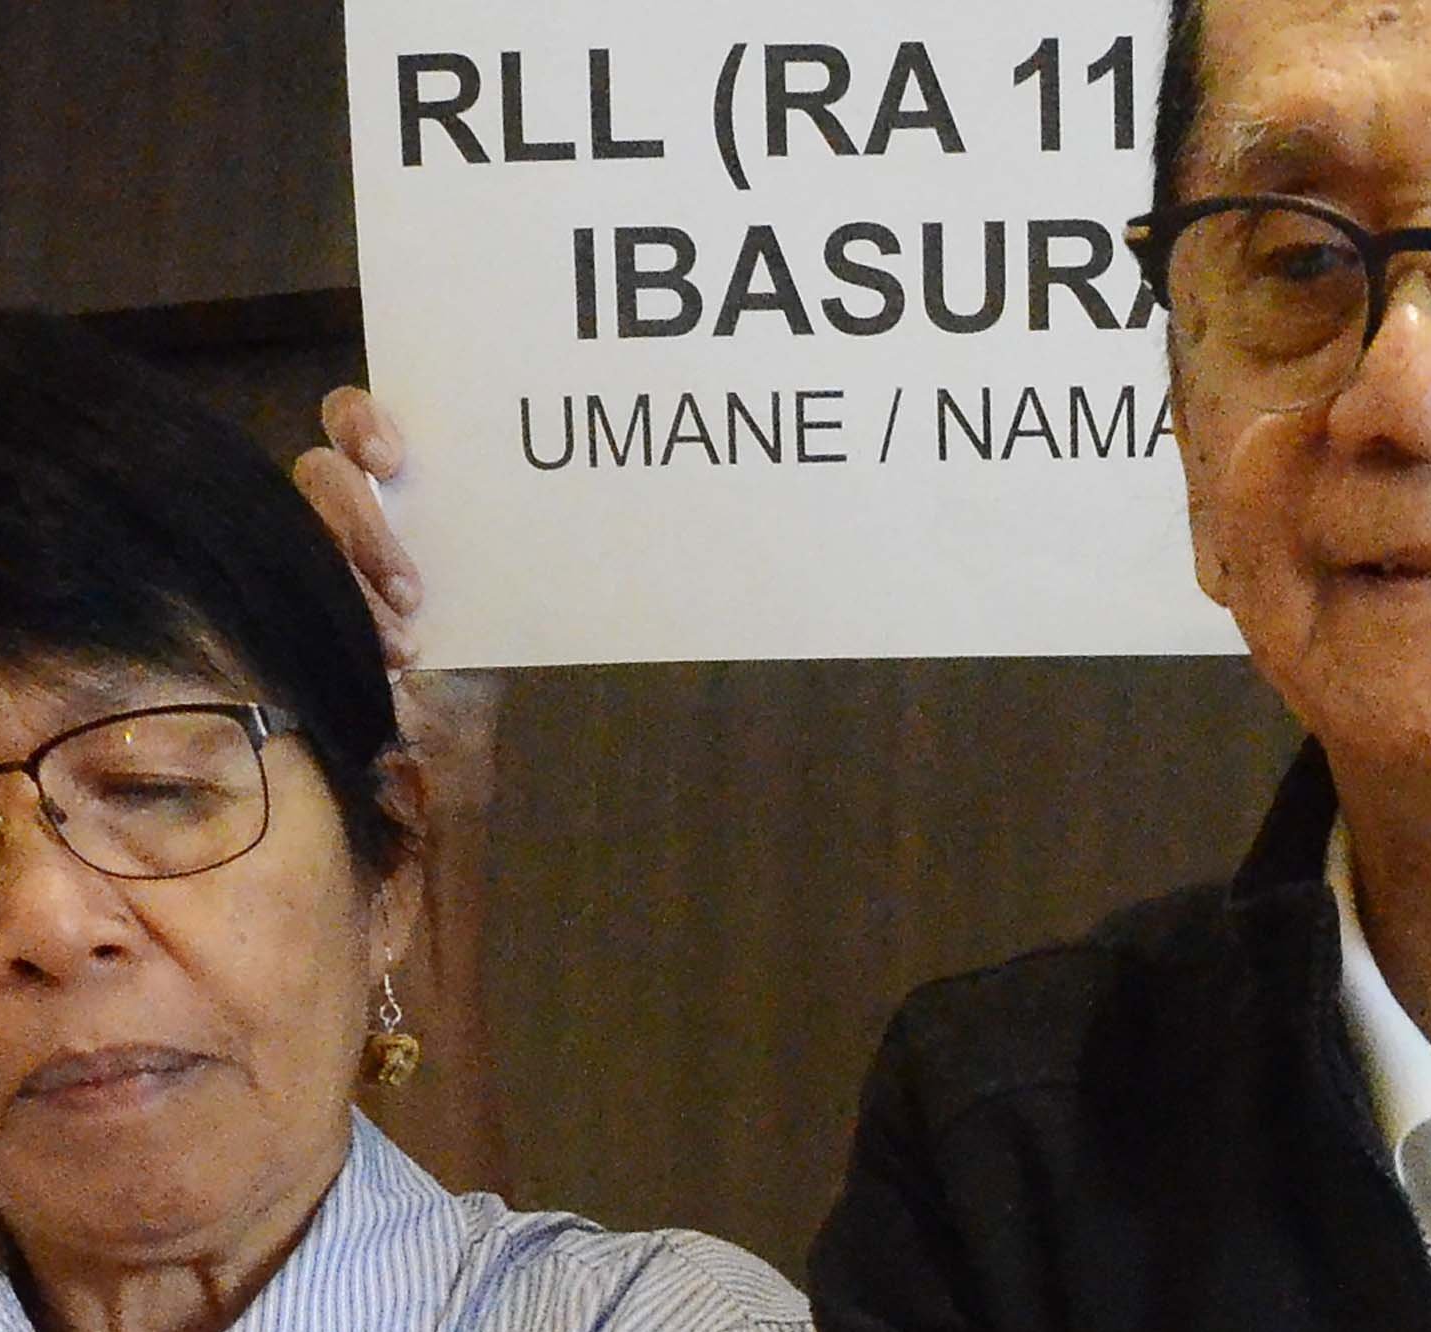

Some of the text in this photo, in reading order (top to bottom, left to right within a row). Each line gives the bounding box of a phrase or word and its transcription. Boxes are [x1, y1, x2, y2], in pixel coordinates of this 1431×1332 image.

[396, 36, 1136, 190] RLL (RA 11
[520, 390, 847, 471] UMANE
[879, 388, 903, 463] /
